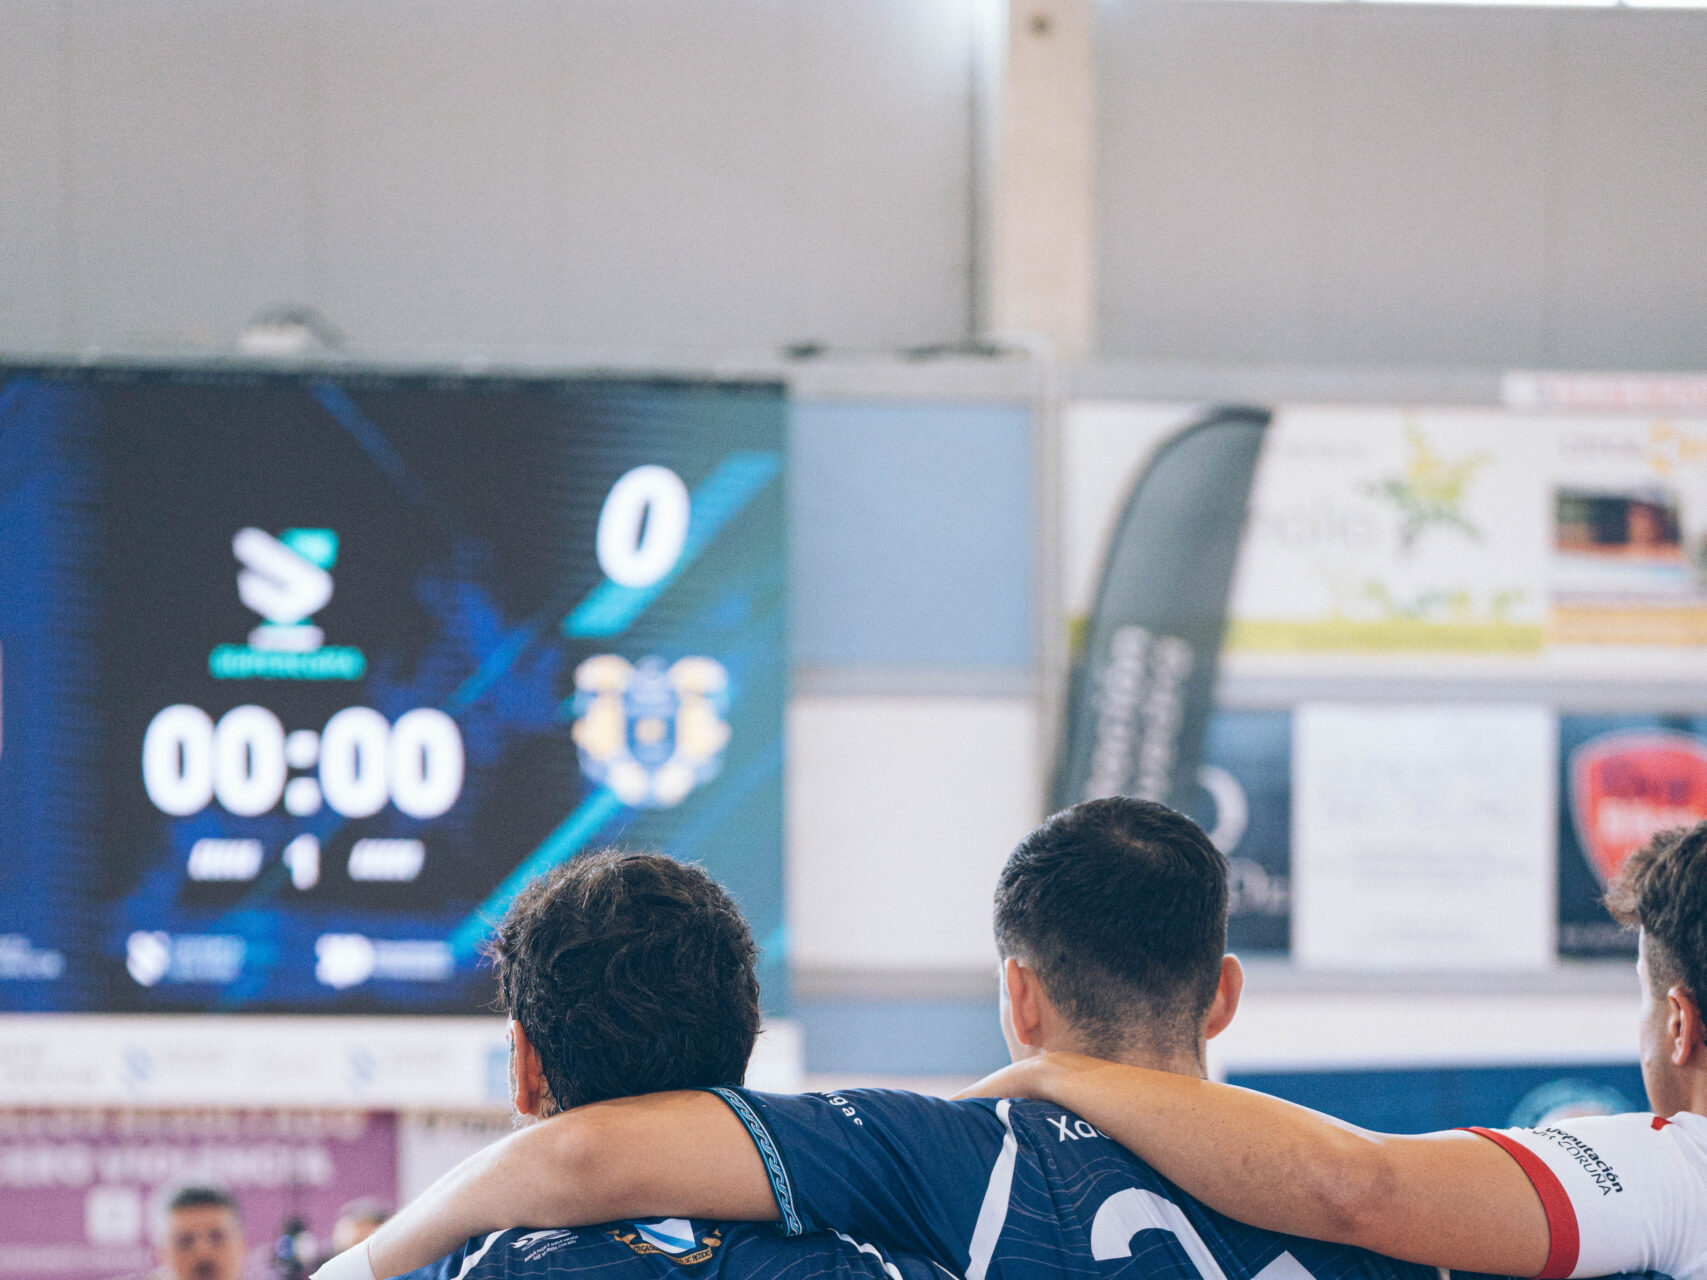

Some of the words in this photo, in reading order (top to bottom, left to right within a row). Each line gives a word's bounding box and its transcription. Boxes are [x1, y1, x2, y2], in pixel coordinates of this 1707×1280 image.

[597, 464, 691, 589] 0
[142, 703, 465, 819] 00:00
[284, 833, 320, 890] 1
[1046, 1115, 1111, 1142] Xa
